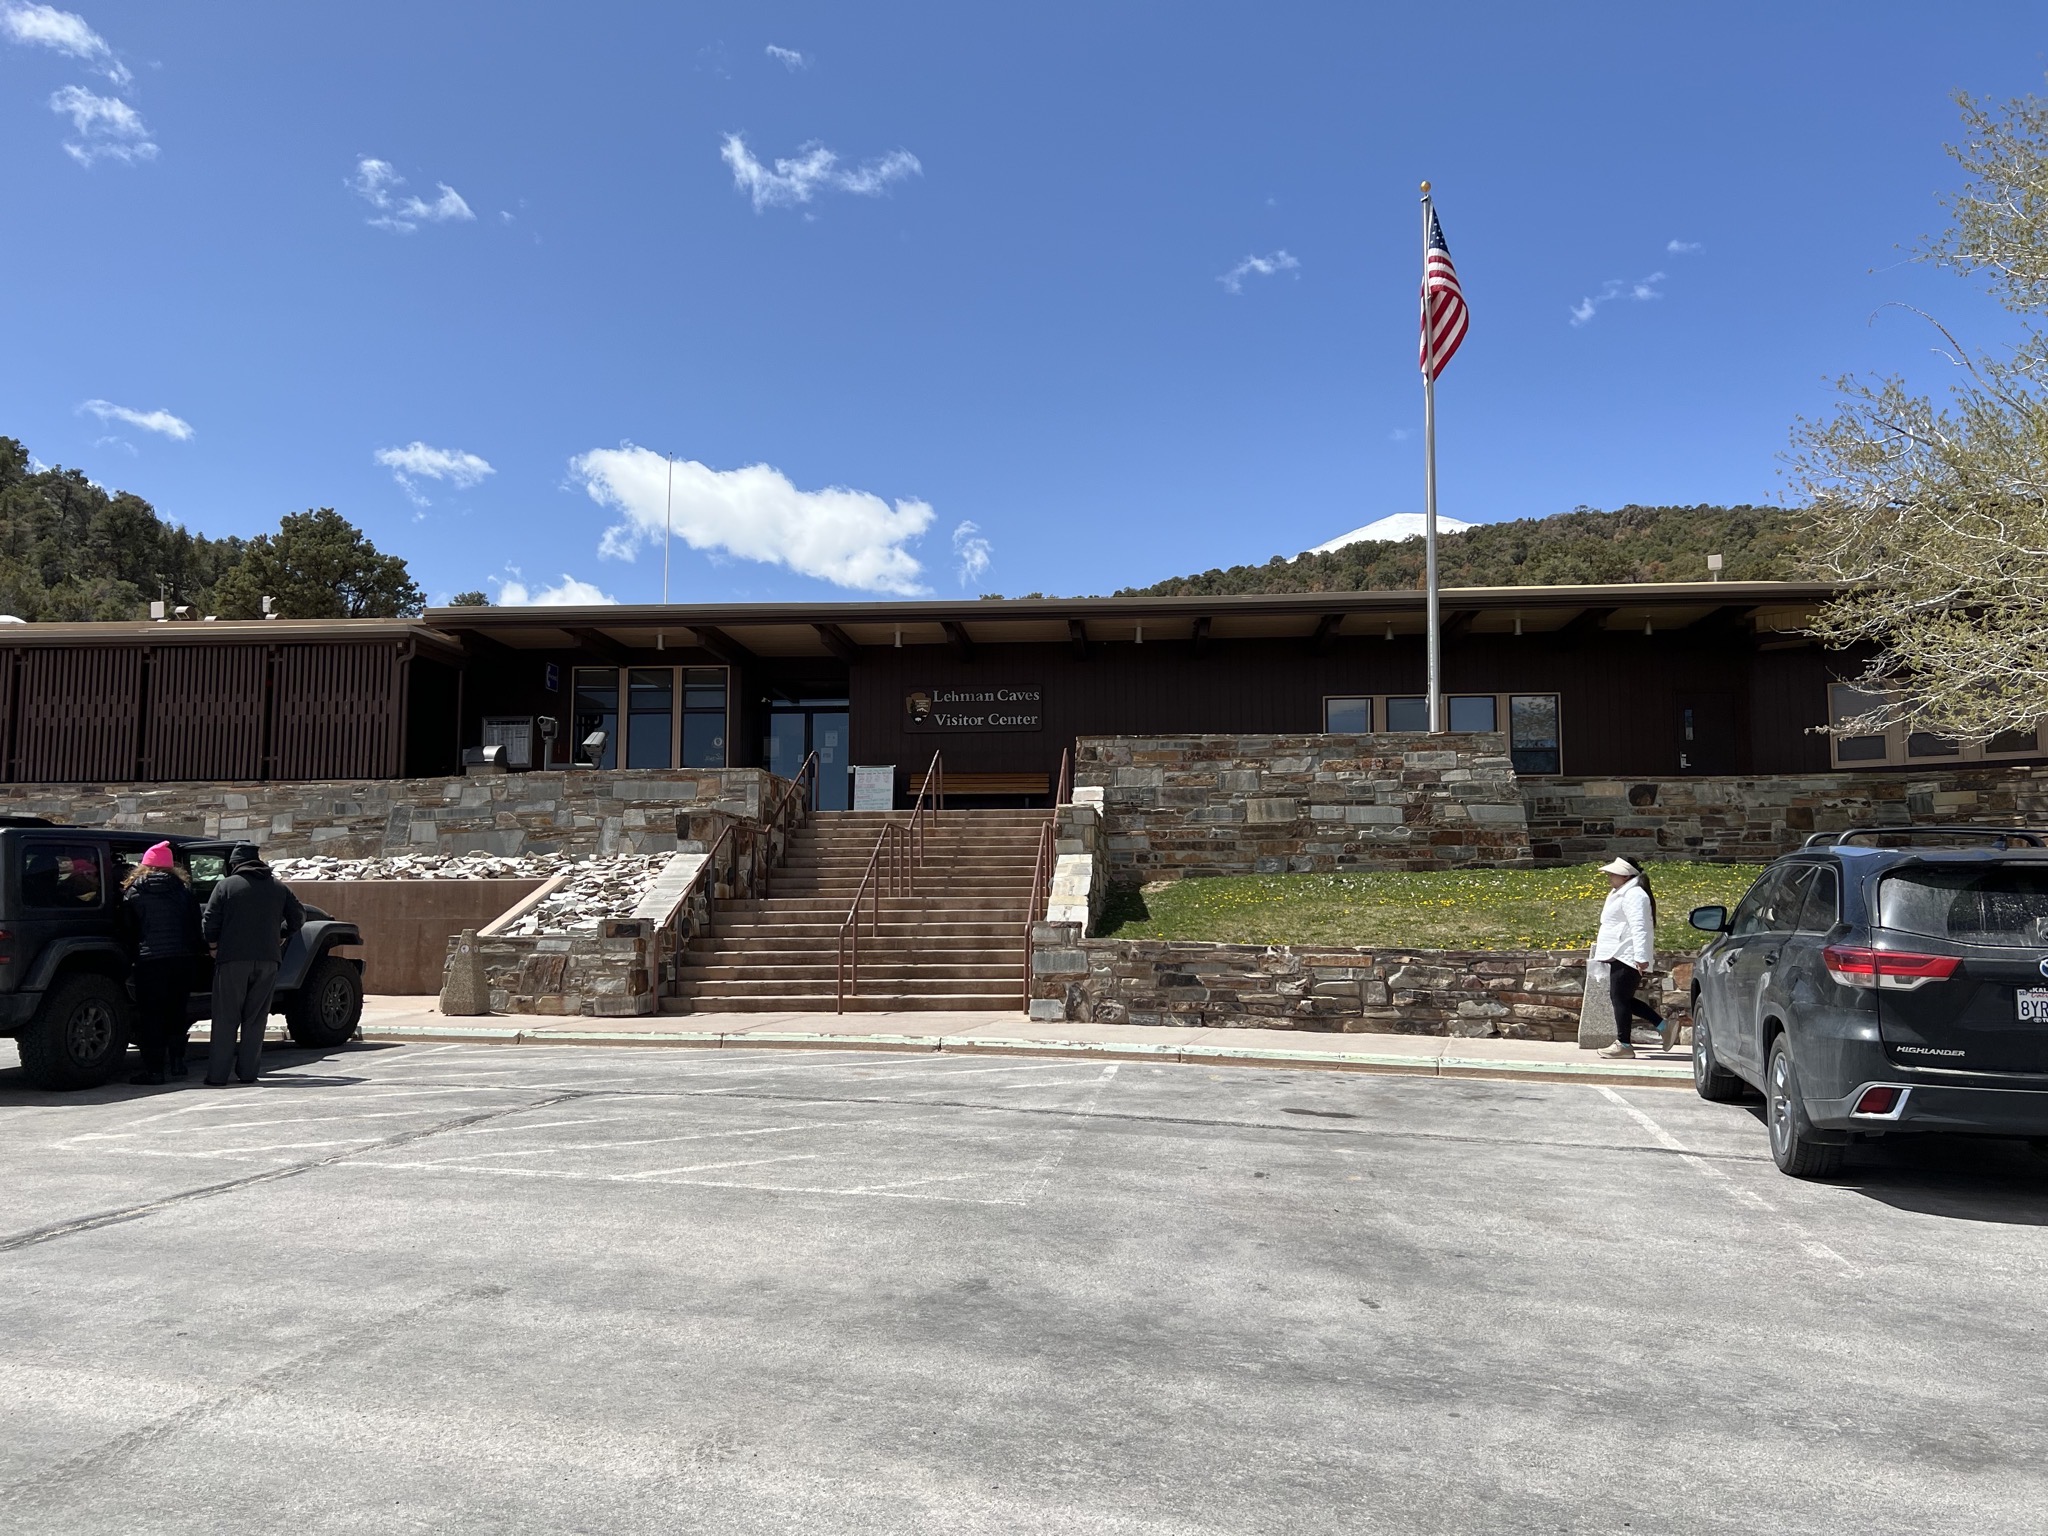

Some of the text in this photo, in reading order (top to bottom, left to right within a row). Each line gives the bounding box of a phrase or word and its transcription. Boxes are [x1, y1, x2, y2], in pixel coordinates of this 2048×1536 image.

[933, 689, 1040, 702] Lehman Caves
[934, 713, 1038, 726] Visitor Center
[1896, 1045, 1966, 1057] HIGHLANDER
